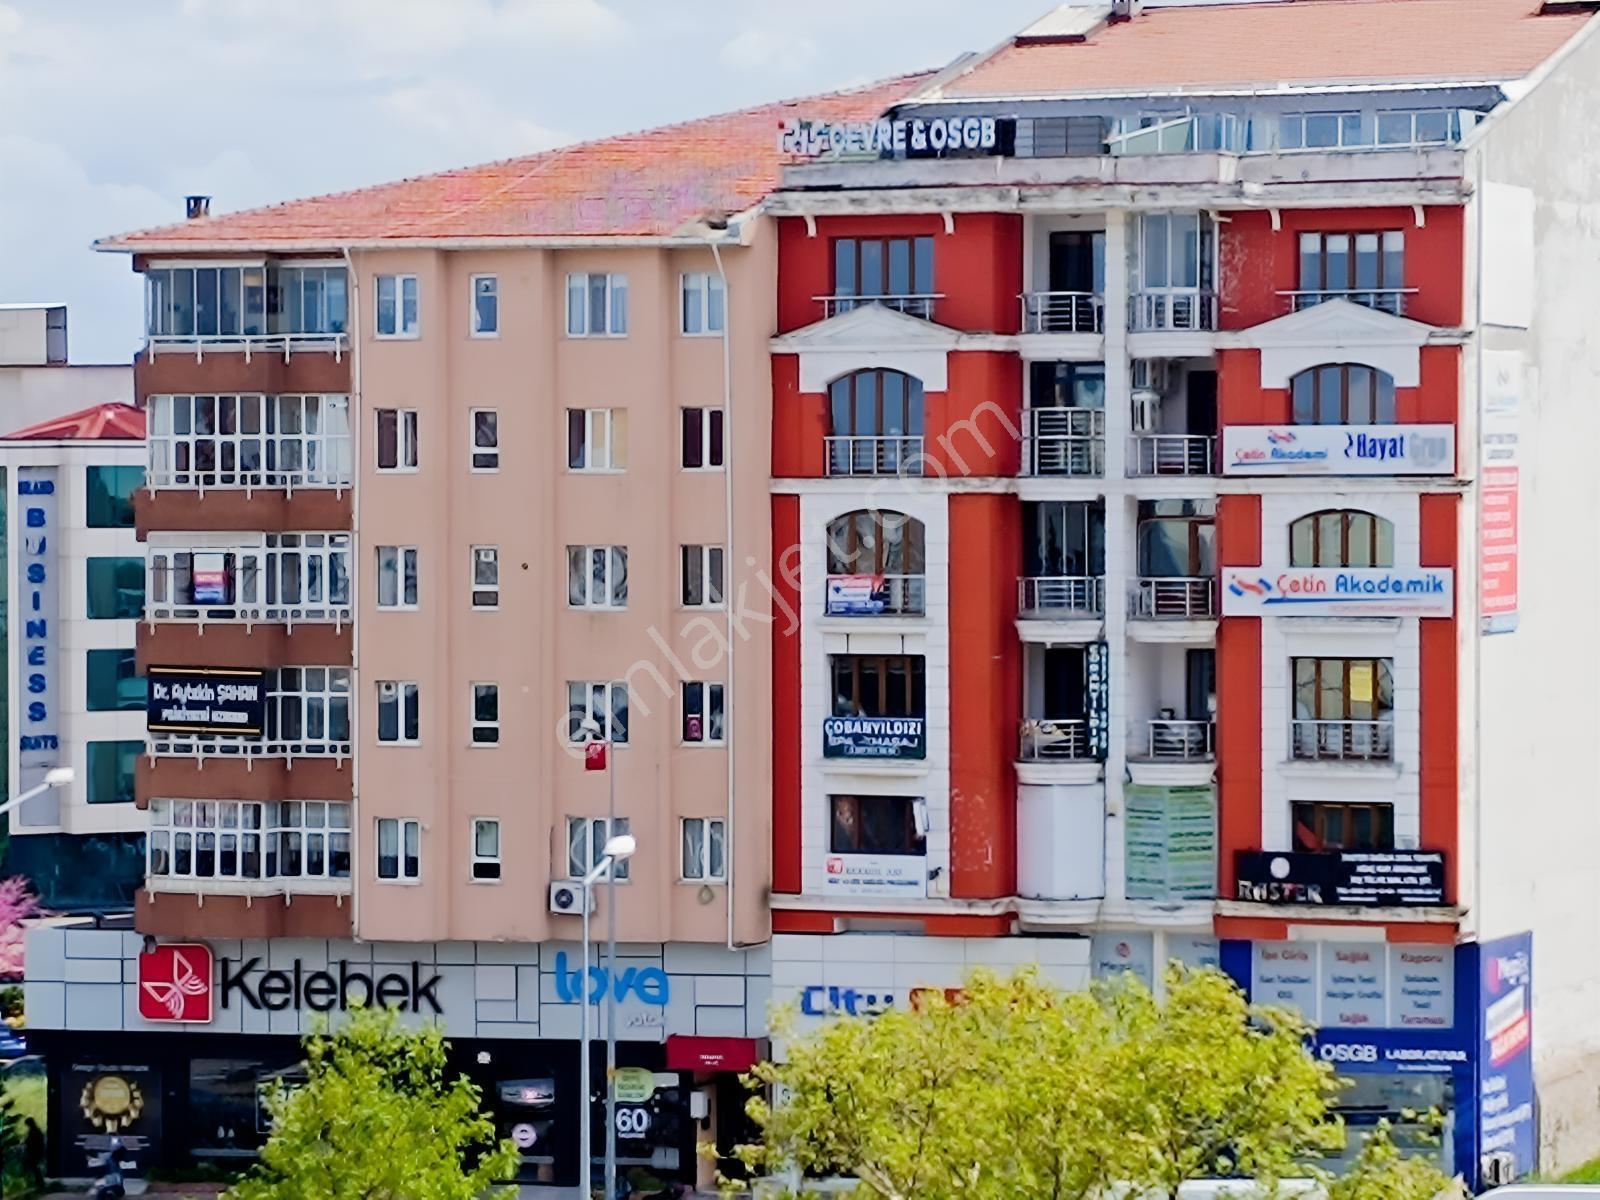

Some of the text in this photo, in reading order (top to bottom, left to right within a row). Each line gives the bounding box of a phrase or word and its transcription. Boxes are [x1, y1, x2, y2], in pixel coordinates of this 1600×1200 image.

[911, 122, 927, 150] &
[930, 117, 996, 150] OSGB
[1276, 573, 1444, 600] Çetin Akademik
[26, 508, 47, 722] BUSINESS
[221, 957, 442, 1014] Kelebek
[1319, 1043, 1378, 1063] OSGB
[615, 1107, 650, 1133] 60
